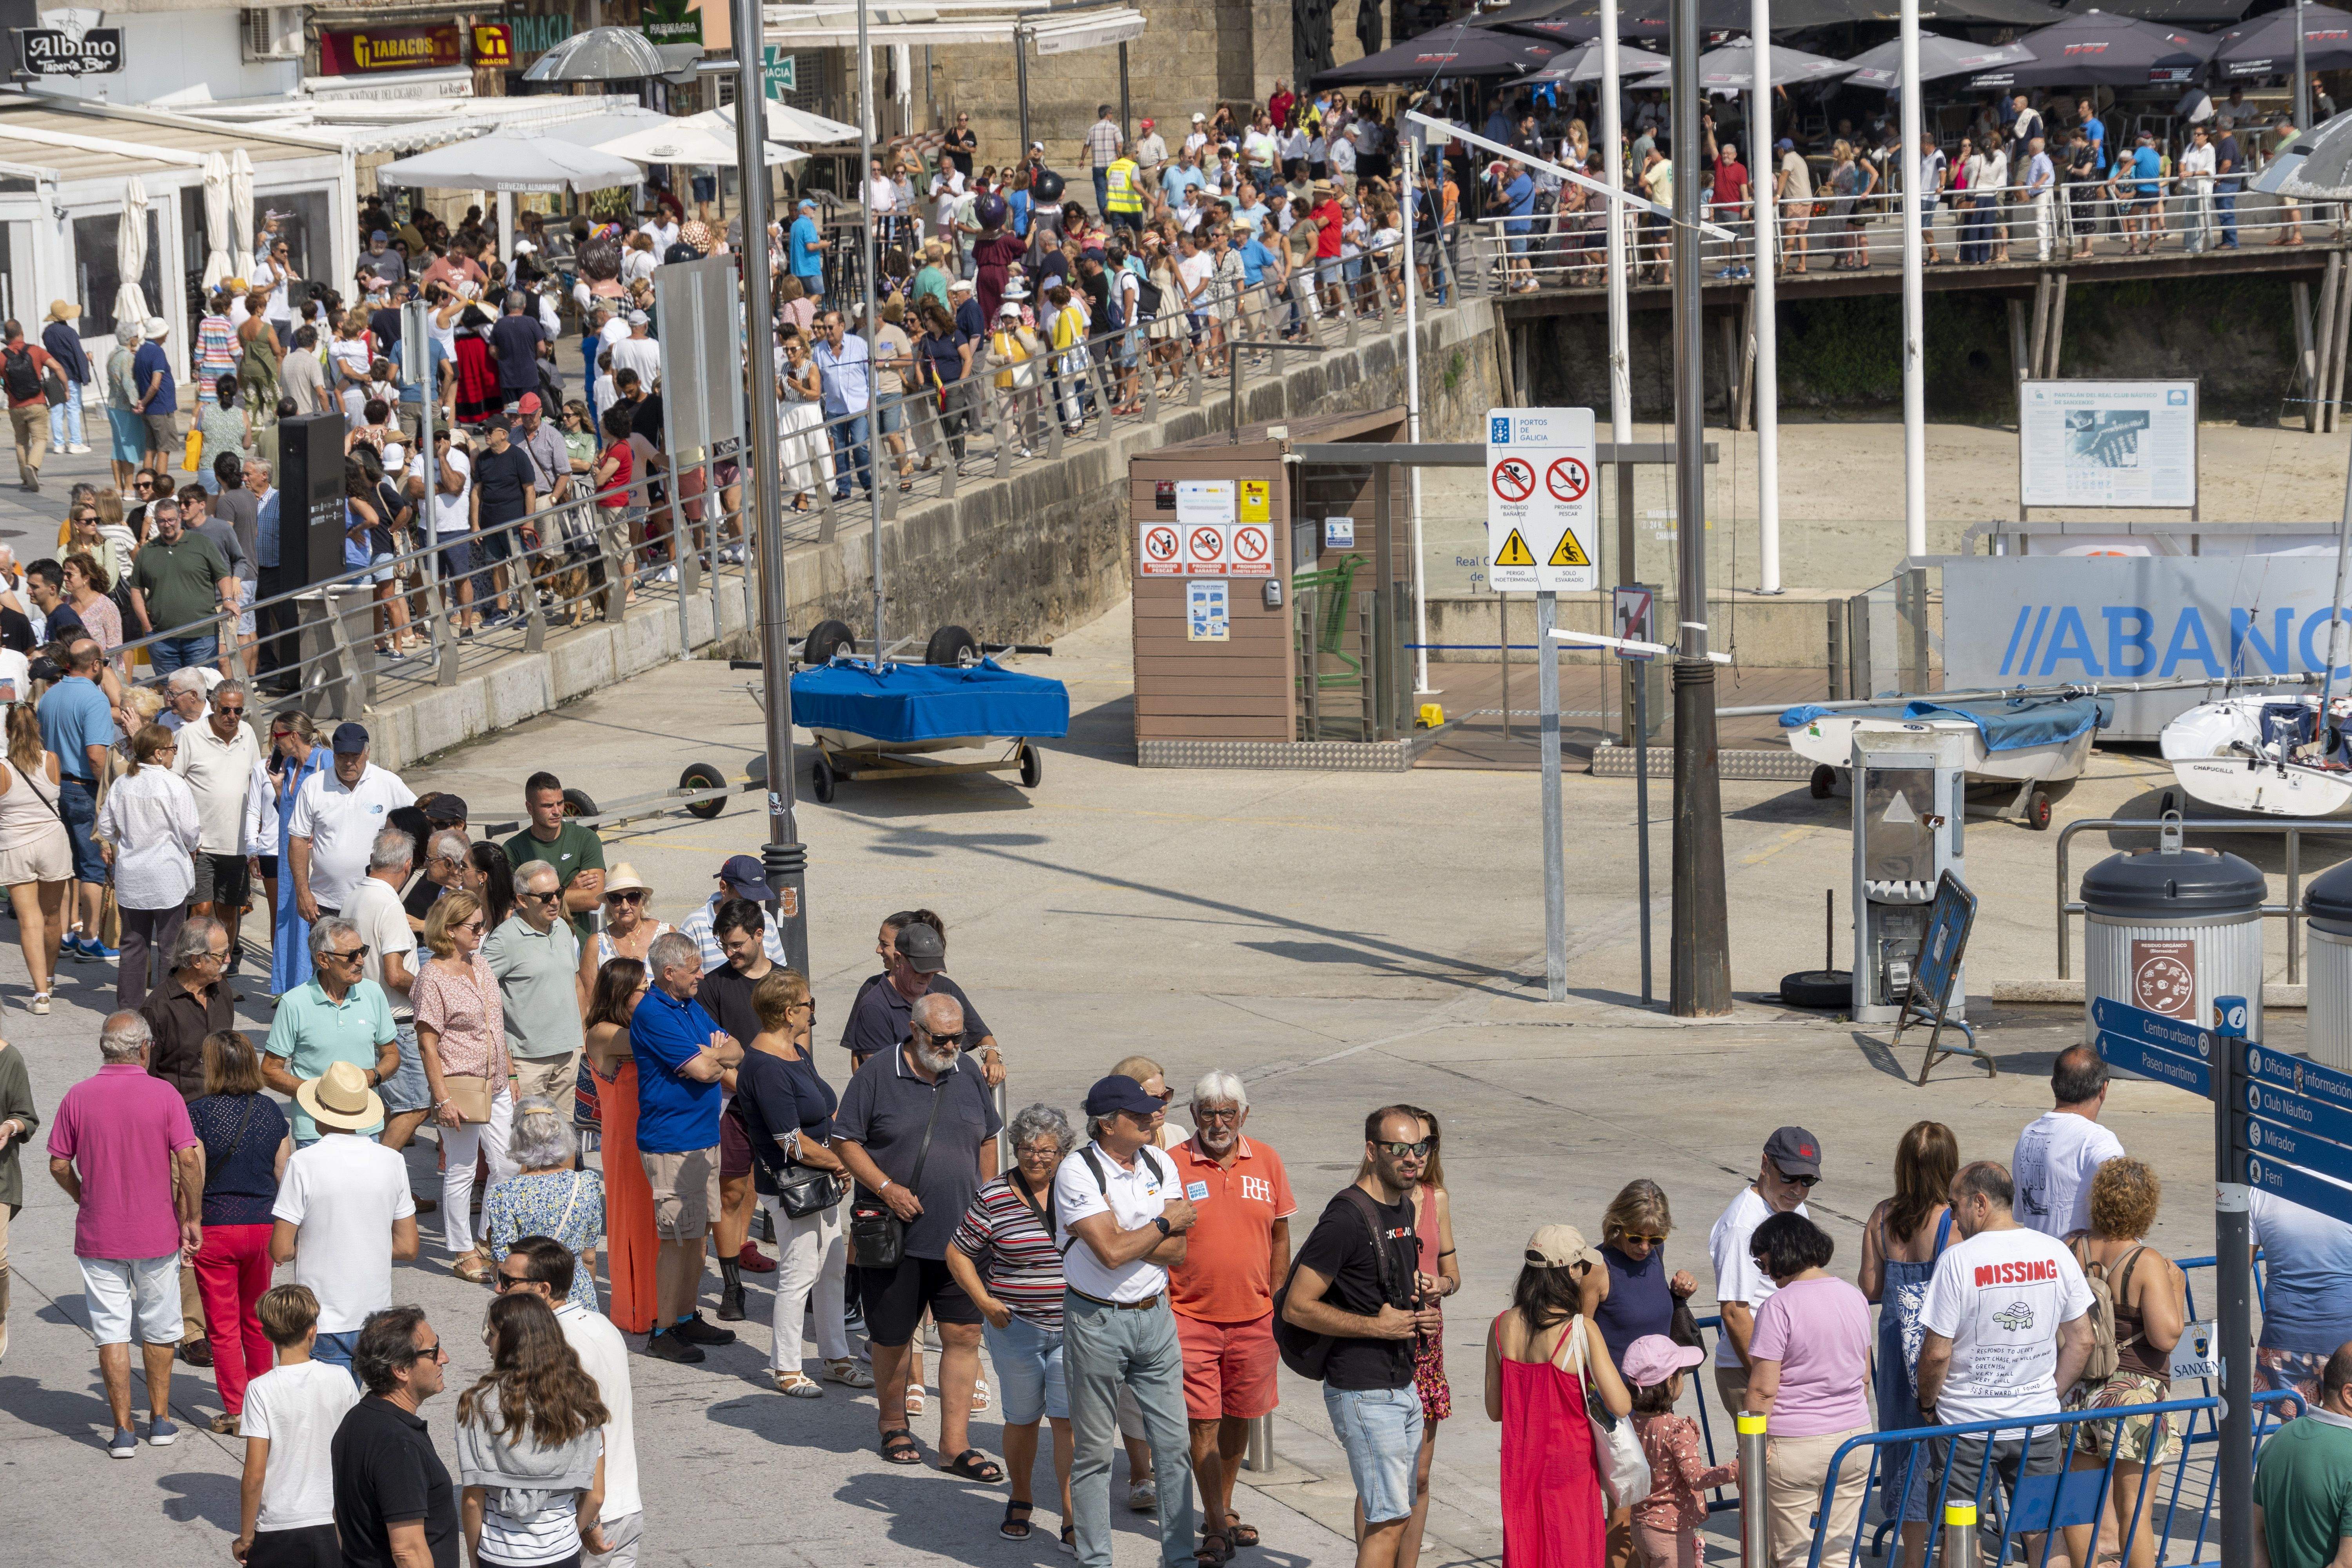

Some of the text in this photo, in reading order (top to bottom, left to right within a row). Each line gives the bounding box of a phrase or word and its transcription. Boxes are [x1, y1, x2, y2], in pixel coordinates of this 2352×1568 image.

[650, 22, 697, 34] FARMACIA
[29, 35, 116, 56] Albino
[372, 37, 434, 58] TABACOS
[81, 57, 112, 73] Bar
[498, 182, 561, 191] CERVEZAS ALHAMBRA
[1456, 556, 1479, 566] Real
[1470, 572, 1484, 581] de
[2194, 765, 2234, 774] CHAPUCILLA
[2144, 1019, 2196, 1047] Centro urbano
[2143, 1052, 2197, 1083] Paseo marítimo
[2265, 1058, 2352, 1099] Oficina información
[2265, 1094, 2312, 1122] Club Náutico
[2265, 1130, 2296, 1152] Mirador
[2265, 1168, 2282, 1187] Ferri
[1975, 1259, 2058, 1287] MISSING
[1992, 1355, 2011, 1364] CHASE,
[1970, 1386, 1982, 1395] $$$
